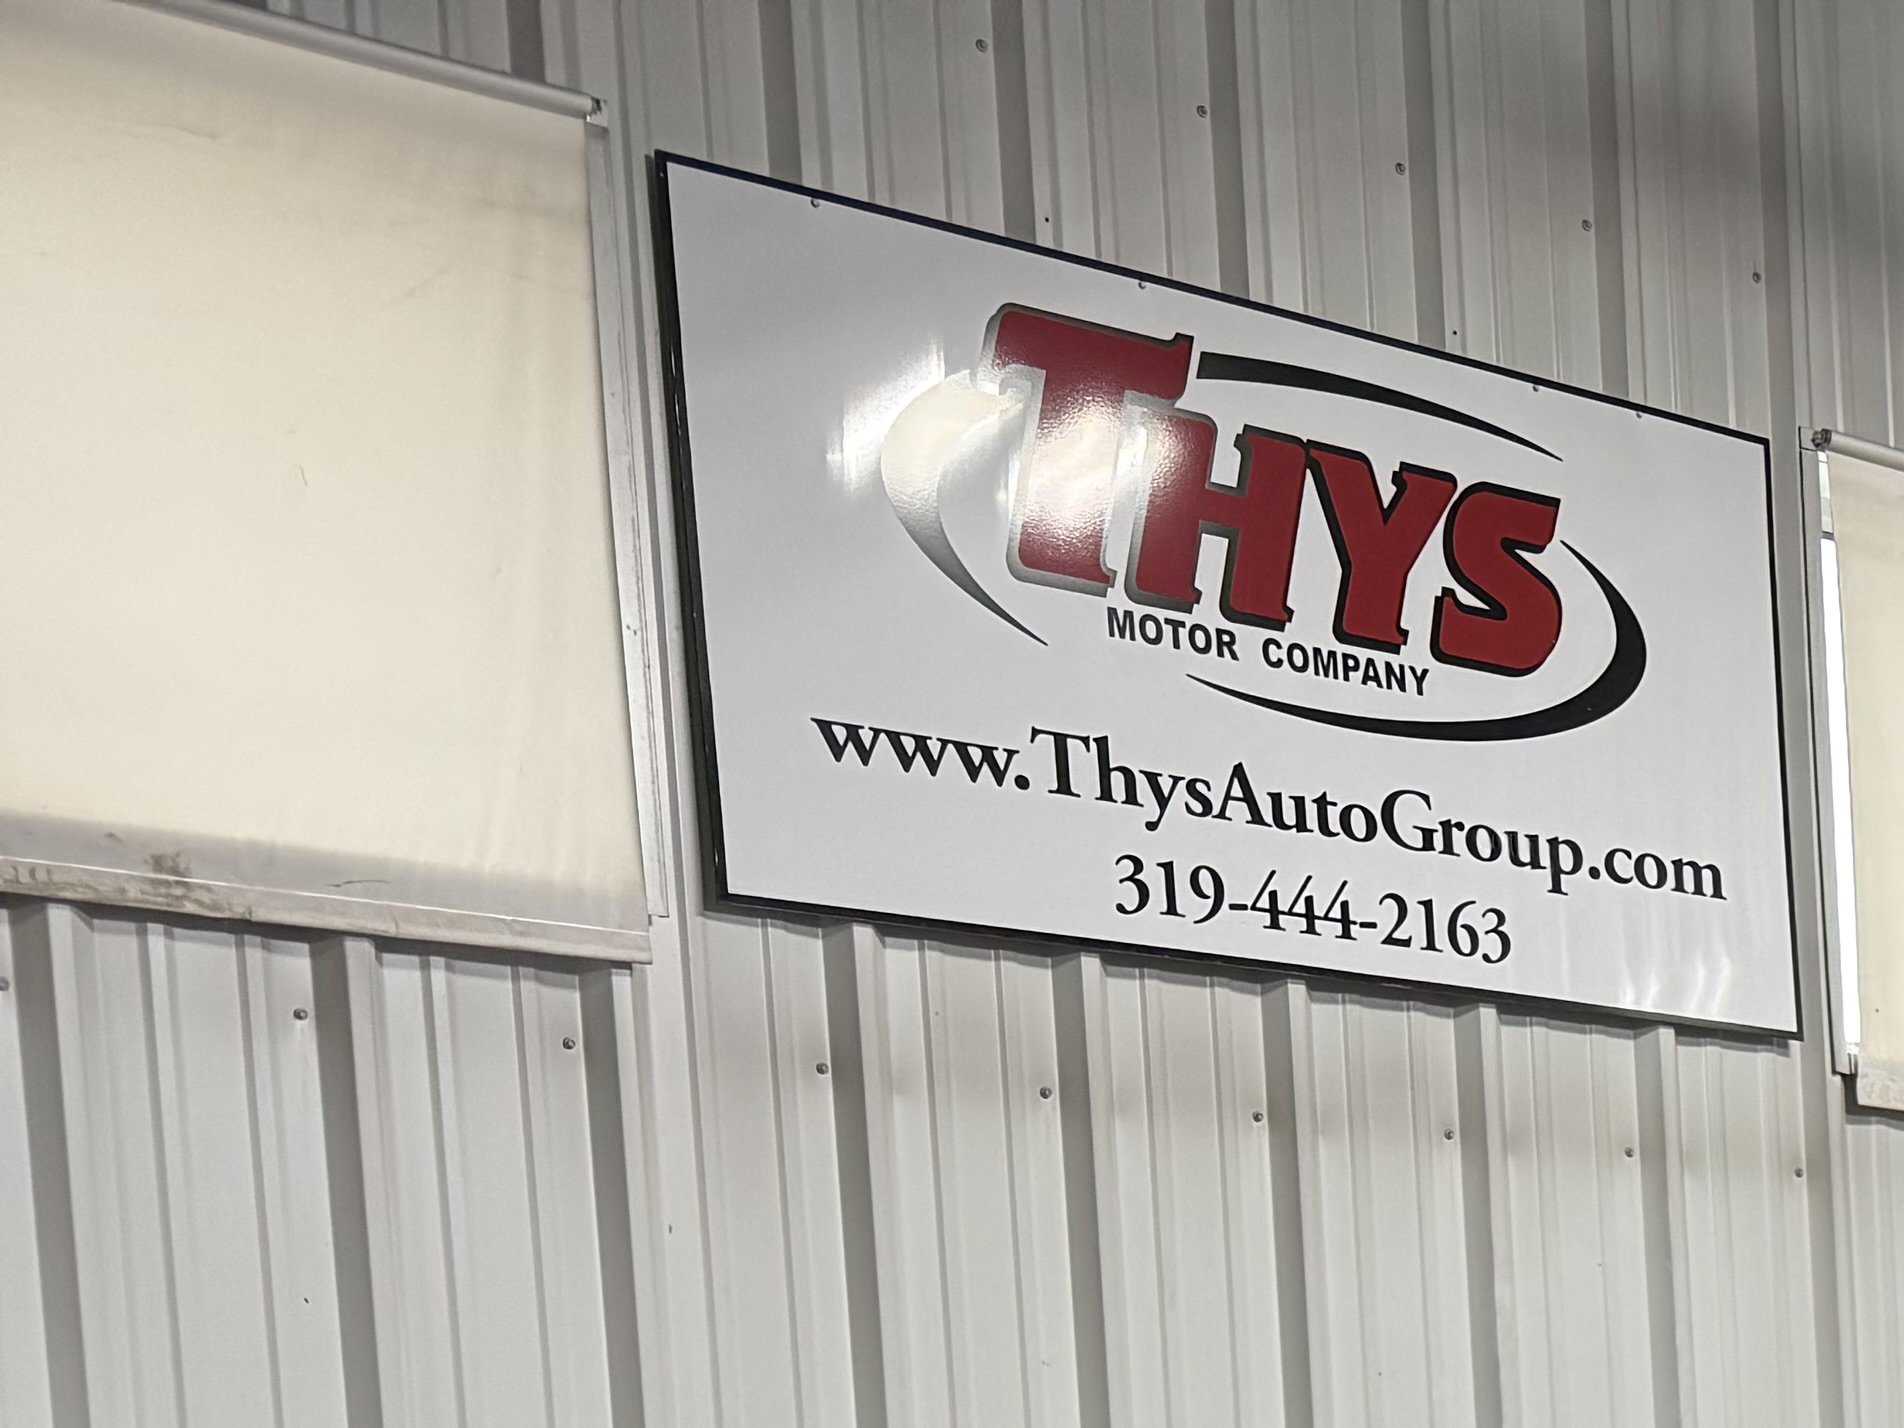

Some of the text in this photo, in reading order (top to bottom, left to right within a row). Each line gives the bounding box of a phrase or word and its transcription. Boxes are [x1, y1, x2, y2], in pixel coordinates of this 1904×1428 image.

[970, 303, 1562, 678] THYS
[1105, 605, 1431, 698] MOTOR COMPANY
[809, 716, 1728, 902] www.ThysAutoGroup.com
[1114, 853, 1512, 965] 319-444-2163
